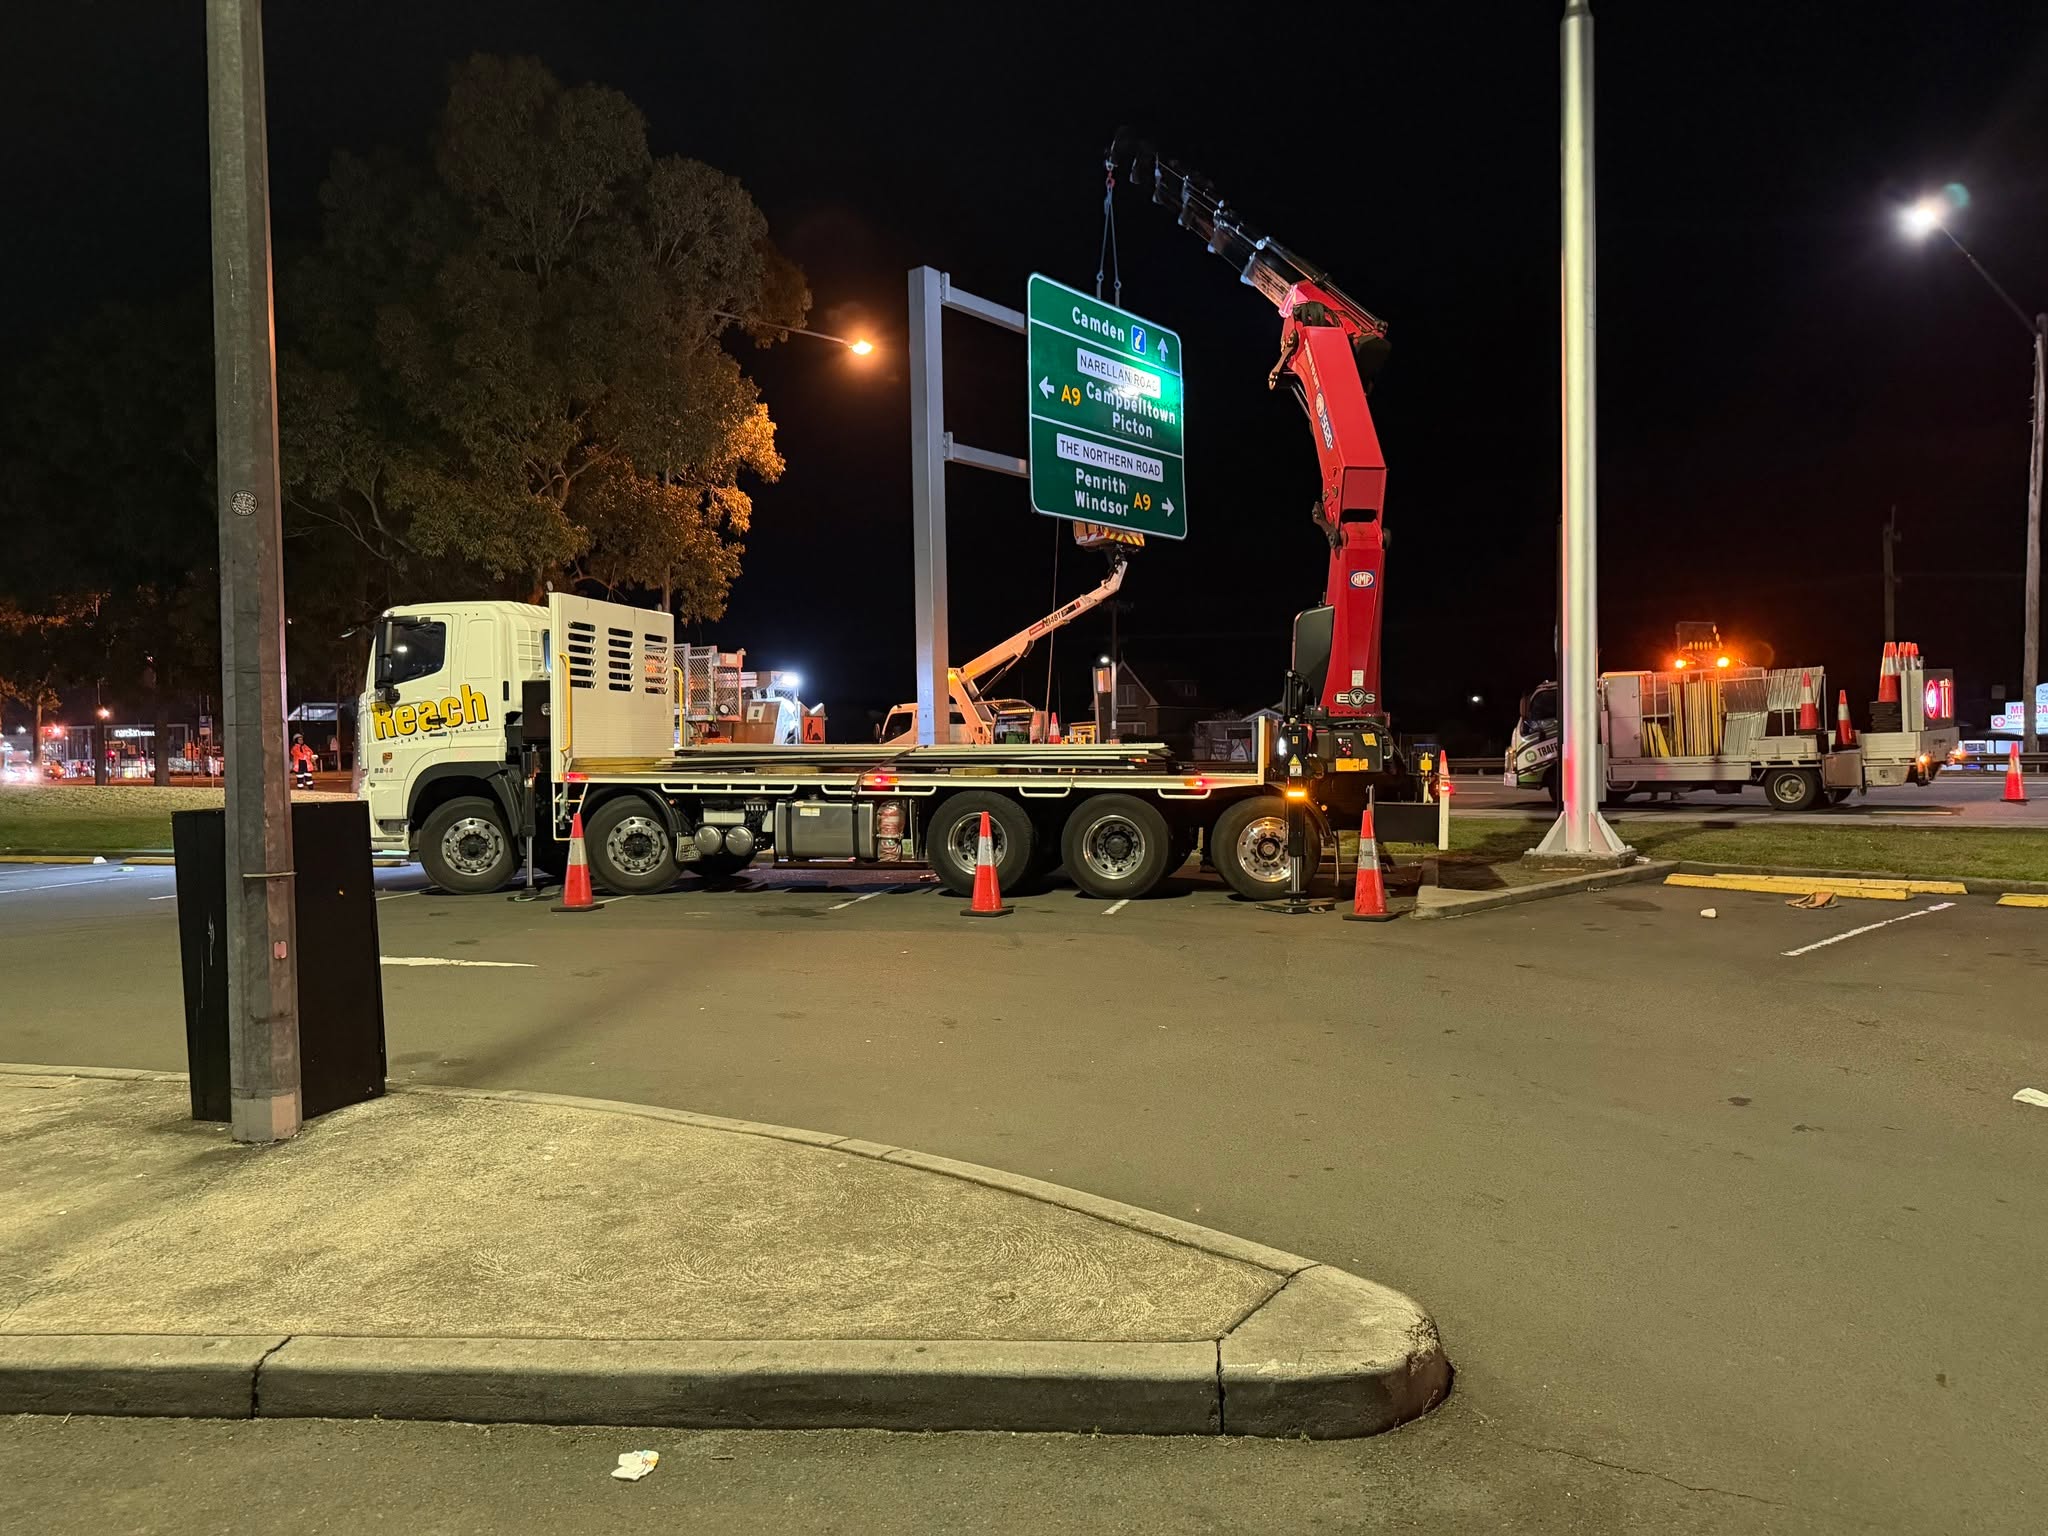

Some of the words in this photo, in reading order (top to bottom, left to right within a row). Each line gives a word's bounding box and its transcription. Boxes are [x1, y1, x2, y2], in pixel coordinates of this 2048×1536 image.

[1072, 306, 1125, 342] Camden
[1080, 355, 1132, 383] NARELLAN
[1133, 374, 1158, 392] ROAD
[1061, 384, 1082, 407] A9
[1086, 381, 1176, 425] Campbelltown
[1112, 411, 1153, 439] Picton
[1060, 439, 1080, 457] THE
[1082, 446, 1134, 471] NORTHERN
[1136, 460, 1161, 477] ROAD
[1075, 467, 1127, 495] Penrith
[1074, 489, 1129, 516] Windsor
[1133, 492, 1152, 512] A9
[1353, 573, 1371, 585] HMF
[371, 684, 489, 740] Reach
[393, 734, 425, 745] CRANE
